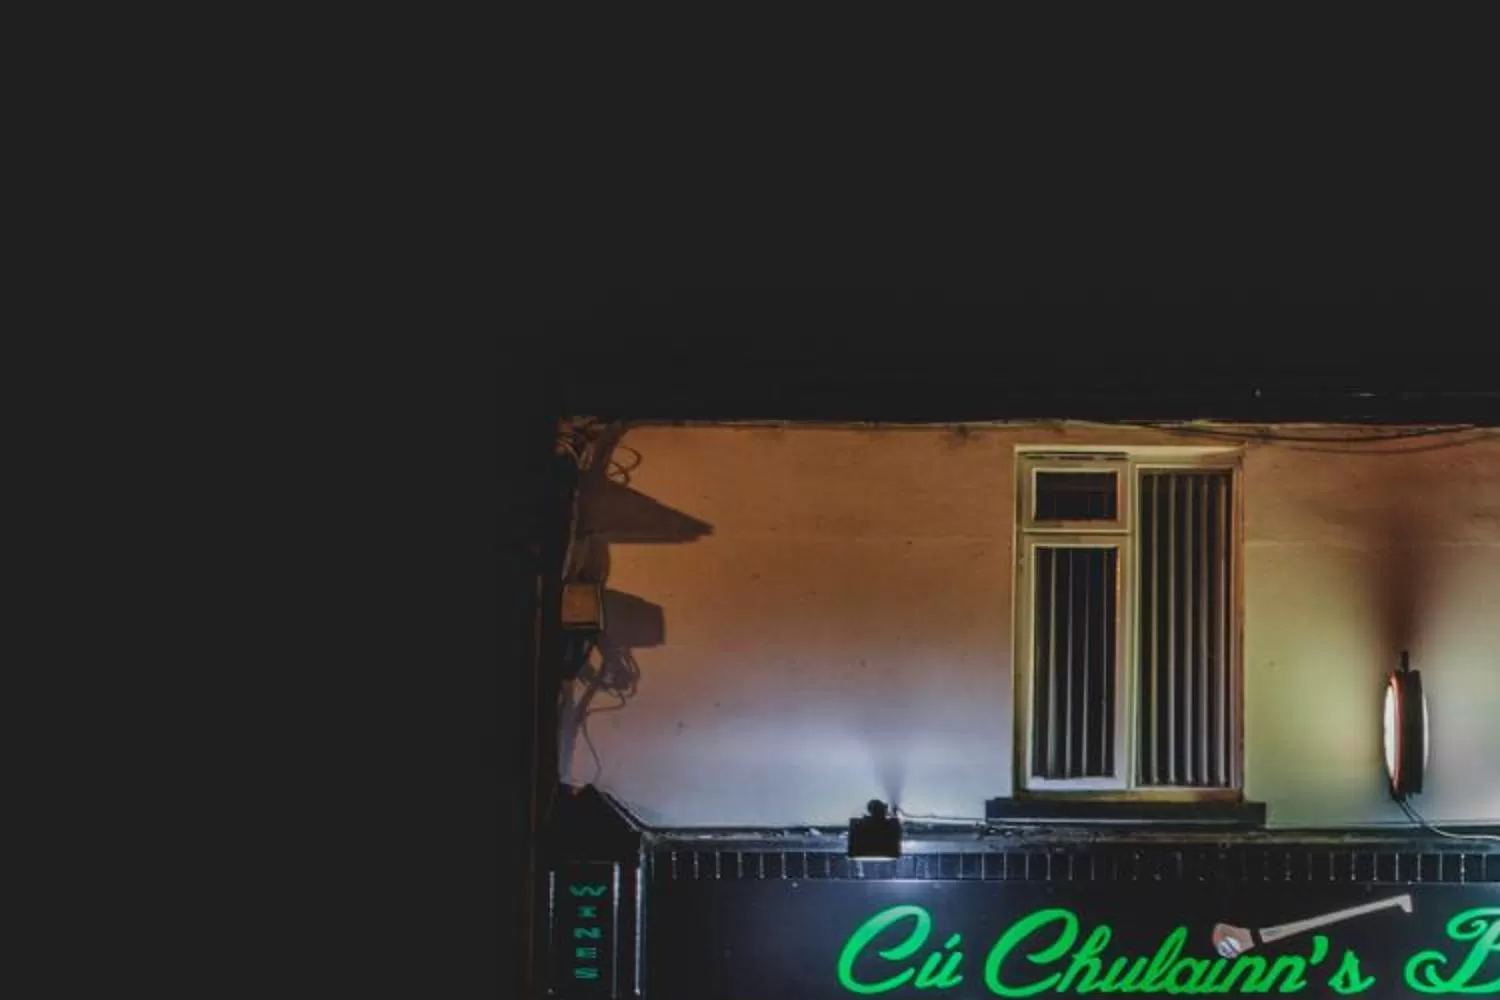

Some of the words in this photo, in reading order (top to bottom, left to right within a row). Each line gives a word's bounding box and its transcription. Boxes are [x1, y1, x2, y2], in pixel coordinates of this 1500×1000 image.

[569, 885, 607, 980] WINES
[837, 904, 963, 996] Cú
[984, 909, 1376, 997] Chulainn's
